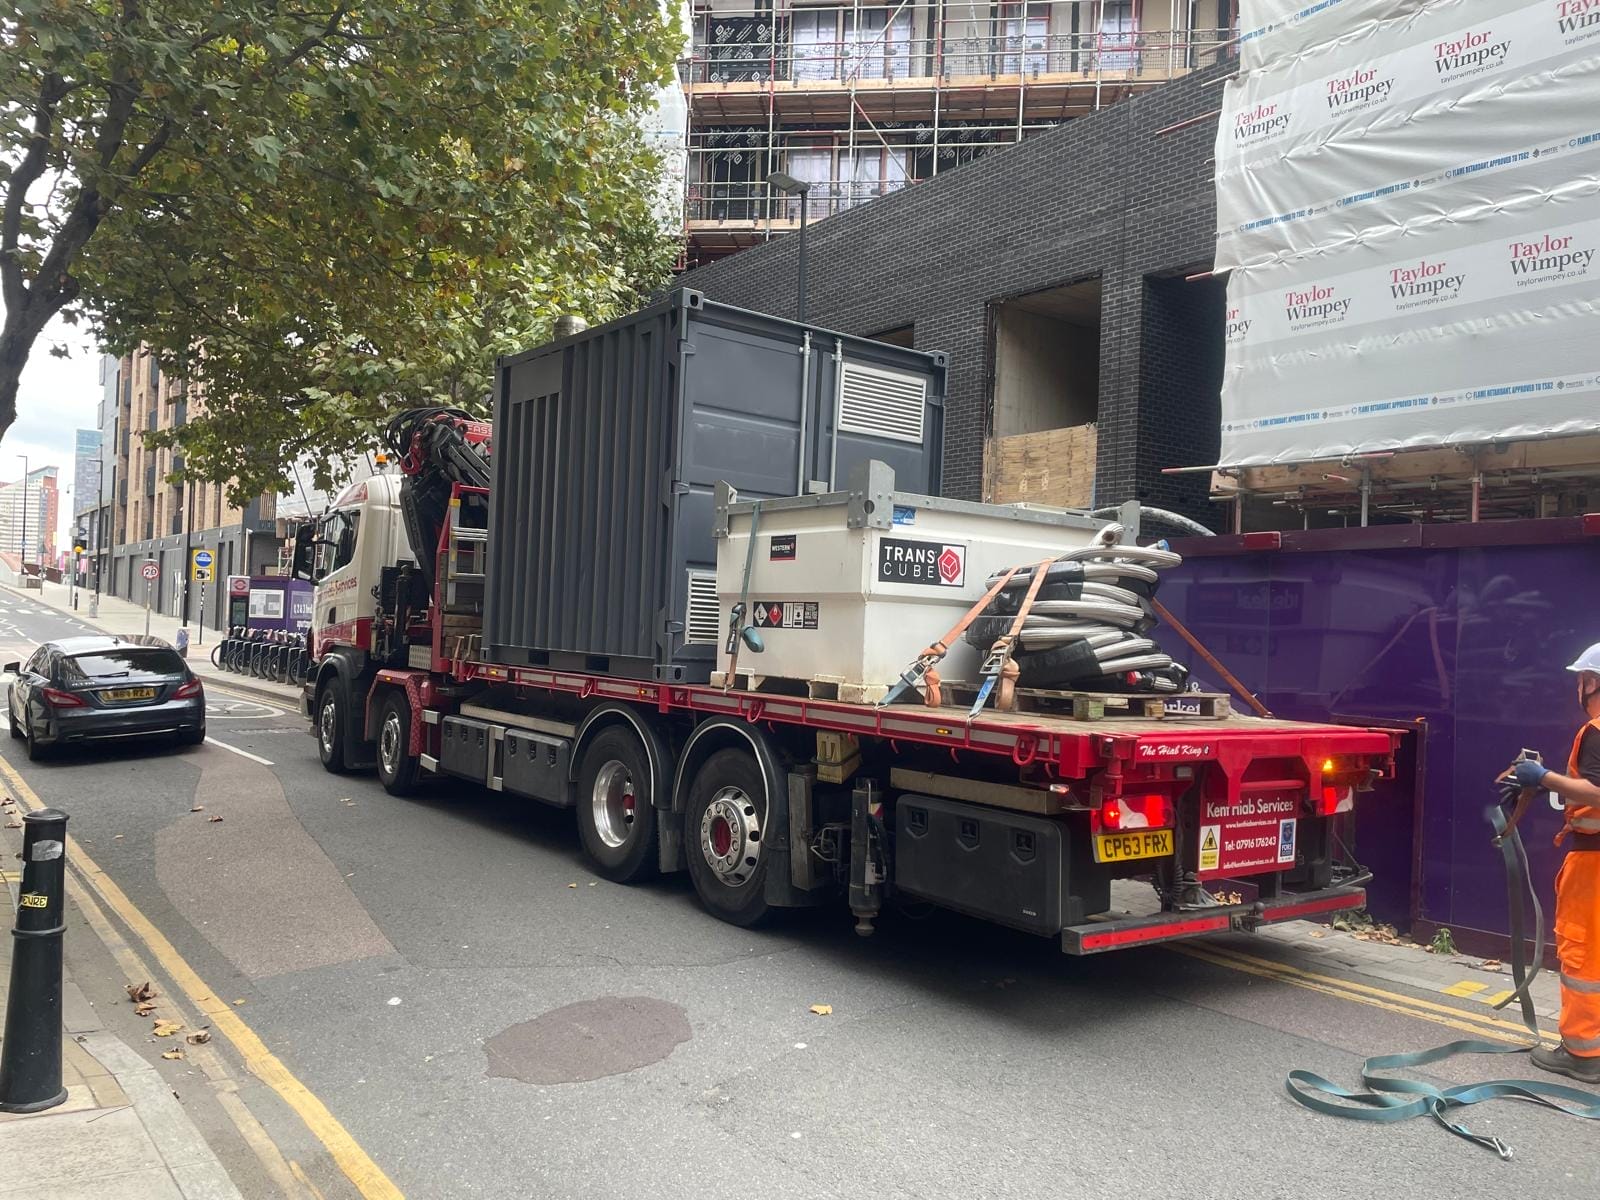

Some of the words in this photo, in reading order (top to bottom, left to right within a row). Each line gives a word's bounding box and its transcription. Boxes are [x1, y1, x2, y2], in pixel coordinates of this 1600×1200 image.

[1434, 31, 1491, 58] Taylor
[1435, 40, 1511, 73] Wimpey
[1327, 69, 1377, 94] Taylor
[1440, 60, 1504, 84] taylorwimpey.co.uk
[1327, 78, 1395, 109] Wimpey
[1235, 104, 1277, 126] Taylor
[1331, 96, 1388, 118] taylorwimpey.co.uk
[1234, 113, 1292, 140] Wimpey
[1452, 167, 1465, 177] FLAME
[1490, 157, 1511, 168] APPROVED
[1509, 234, 1573, 259] Taylor
[1389, 261, 1446, 284] Taylor
[1510, 248, 1596, 275] Wimpey
[1390, 274, 1466, 299] Wimpey
[1517, 268, 1587, 287] taylorwimpey.co.uk
[1285, 285, 1335, 307] Taylor
[1396, 293, 1459, 311] taylorwimpey.co.uk
[1286, 298, 1352, 321] Wimpey
[1291, 315, 1344, 332] taylorwimpey.co.uk
[1473, 390, 1486, 399] FLAME
[1512, 384, 1534, 393] APPROVED
[884, 545, 936, 565] TRANS
[144, 568, 157, 576] 20
[883, 562, 934, 579] CUBE
[1140, 745, 1156, 757] The
[1158, 745, 1181, 755] Hiab
[1181, 745, 1202, 758] King
[1257, 797, 1294, 814] Services
[1104, 837, 1141, 858] CP63
[1144, 833, 1168, 854] FRX
[1225, 840, 1235, 851] Tel:
[1236, 839, 1255, 850] 07916
[1255, 836, 1277, 848] 176243
